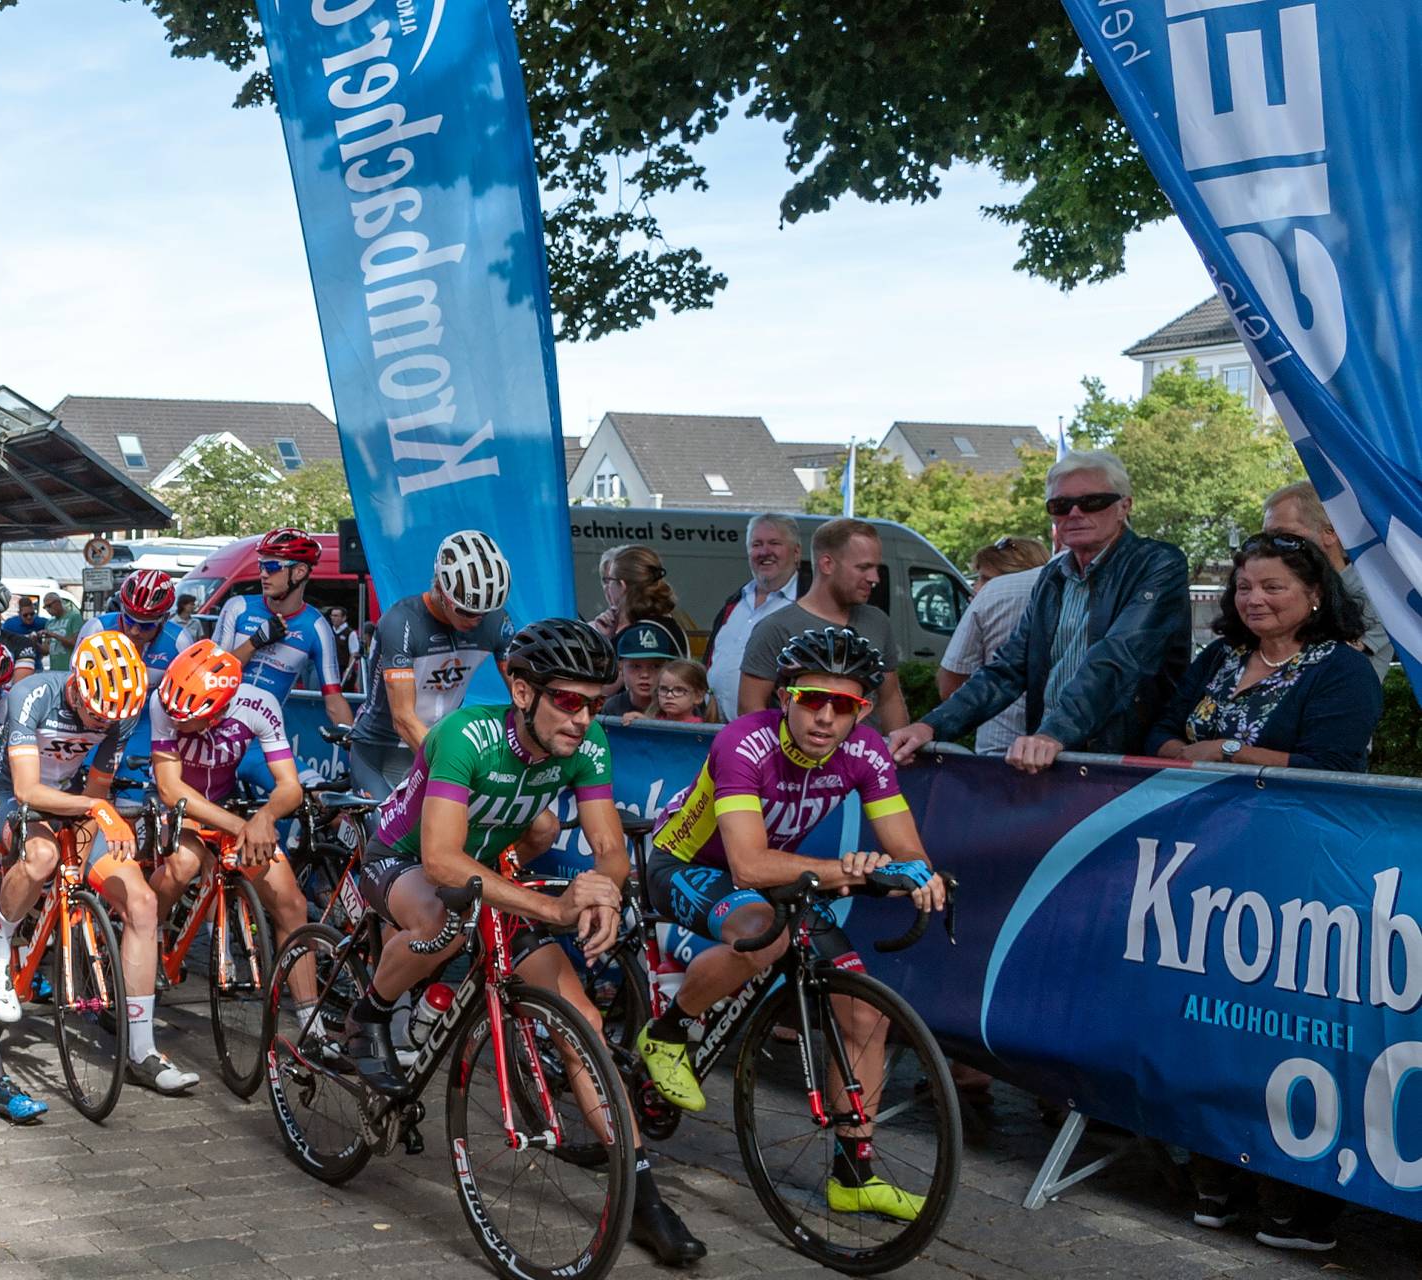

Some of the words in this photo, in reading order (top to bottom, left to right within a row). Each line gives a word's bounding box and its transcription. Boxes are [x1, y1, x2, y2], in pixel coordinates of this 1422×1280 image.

[571, 520, 653, 540] echnical
[661, 523, 739, 542] Service
[204, 674, 238, 690] poc
[1123, 837, 1422, 1011] Kromb
[695, 985, 758, 1069] ARGON
[1184, 994, 1354, 1053] ALKOHOLFREI
